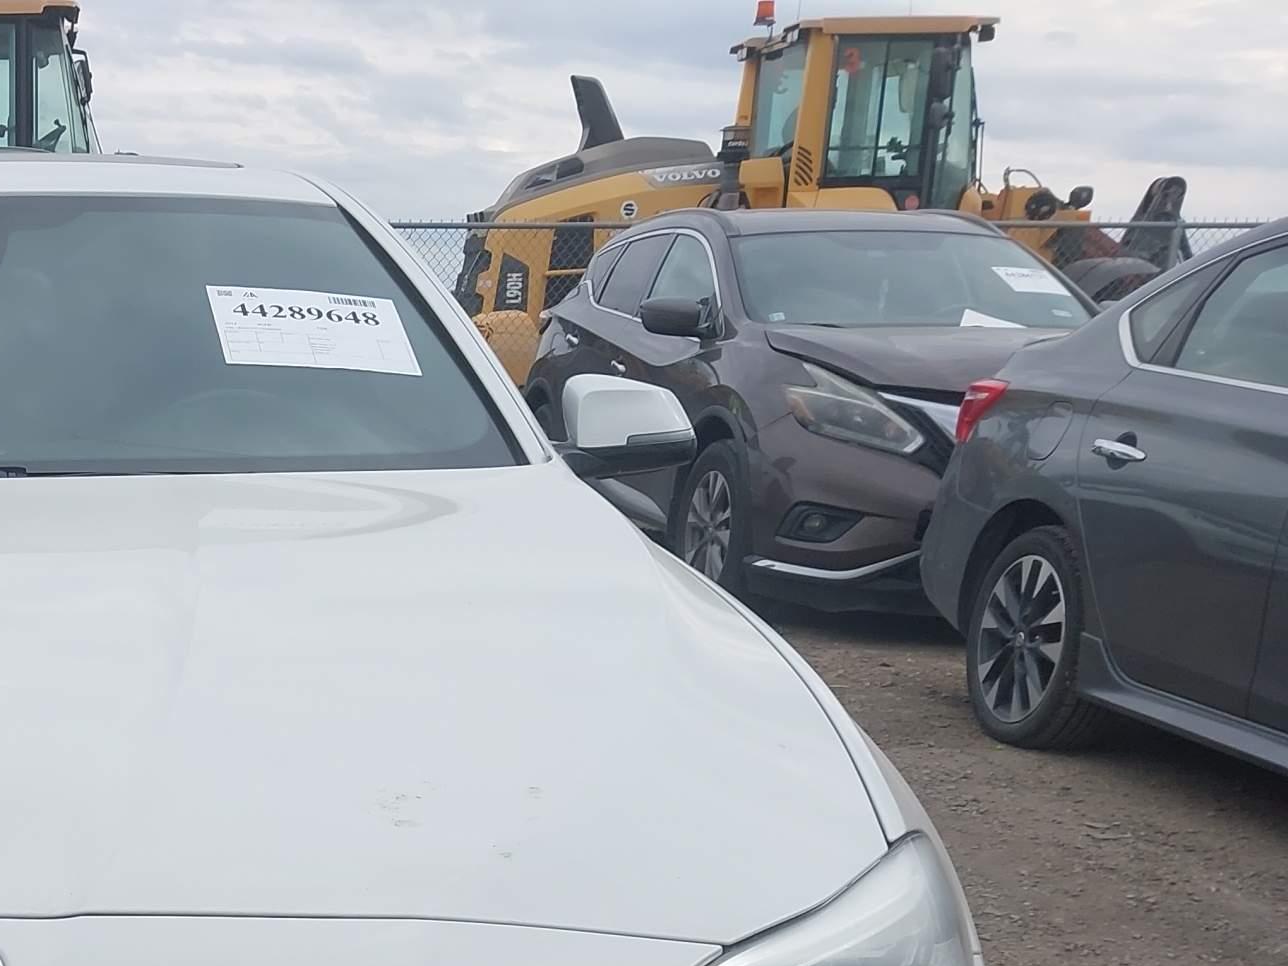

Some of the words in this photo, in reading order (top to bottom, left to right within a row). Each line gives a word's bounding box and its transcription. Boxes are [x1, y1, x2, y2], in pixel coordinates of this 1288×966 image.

[652, 168, 721, 182] VOLVO
[505, 272, 523, 304] L90H
[232, 302, 381, 327] 44289648
